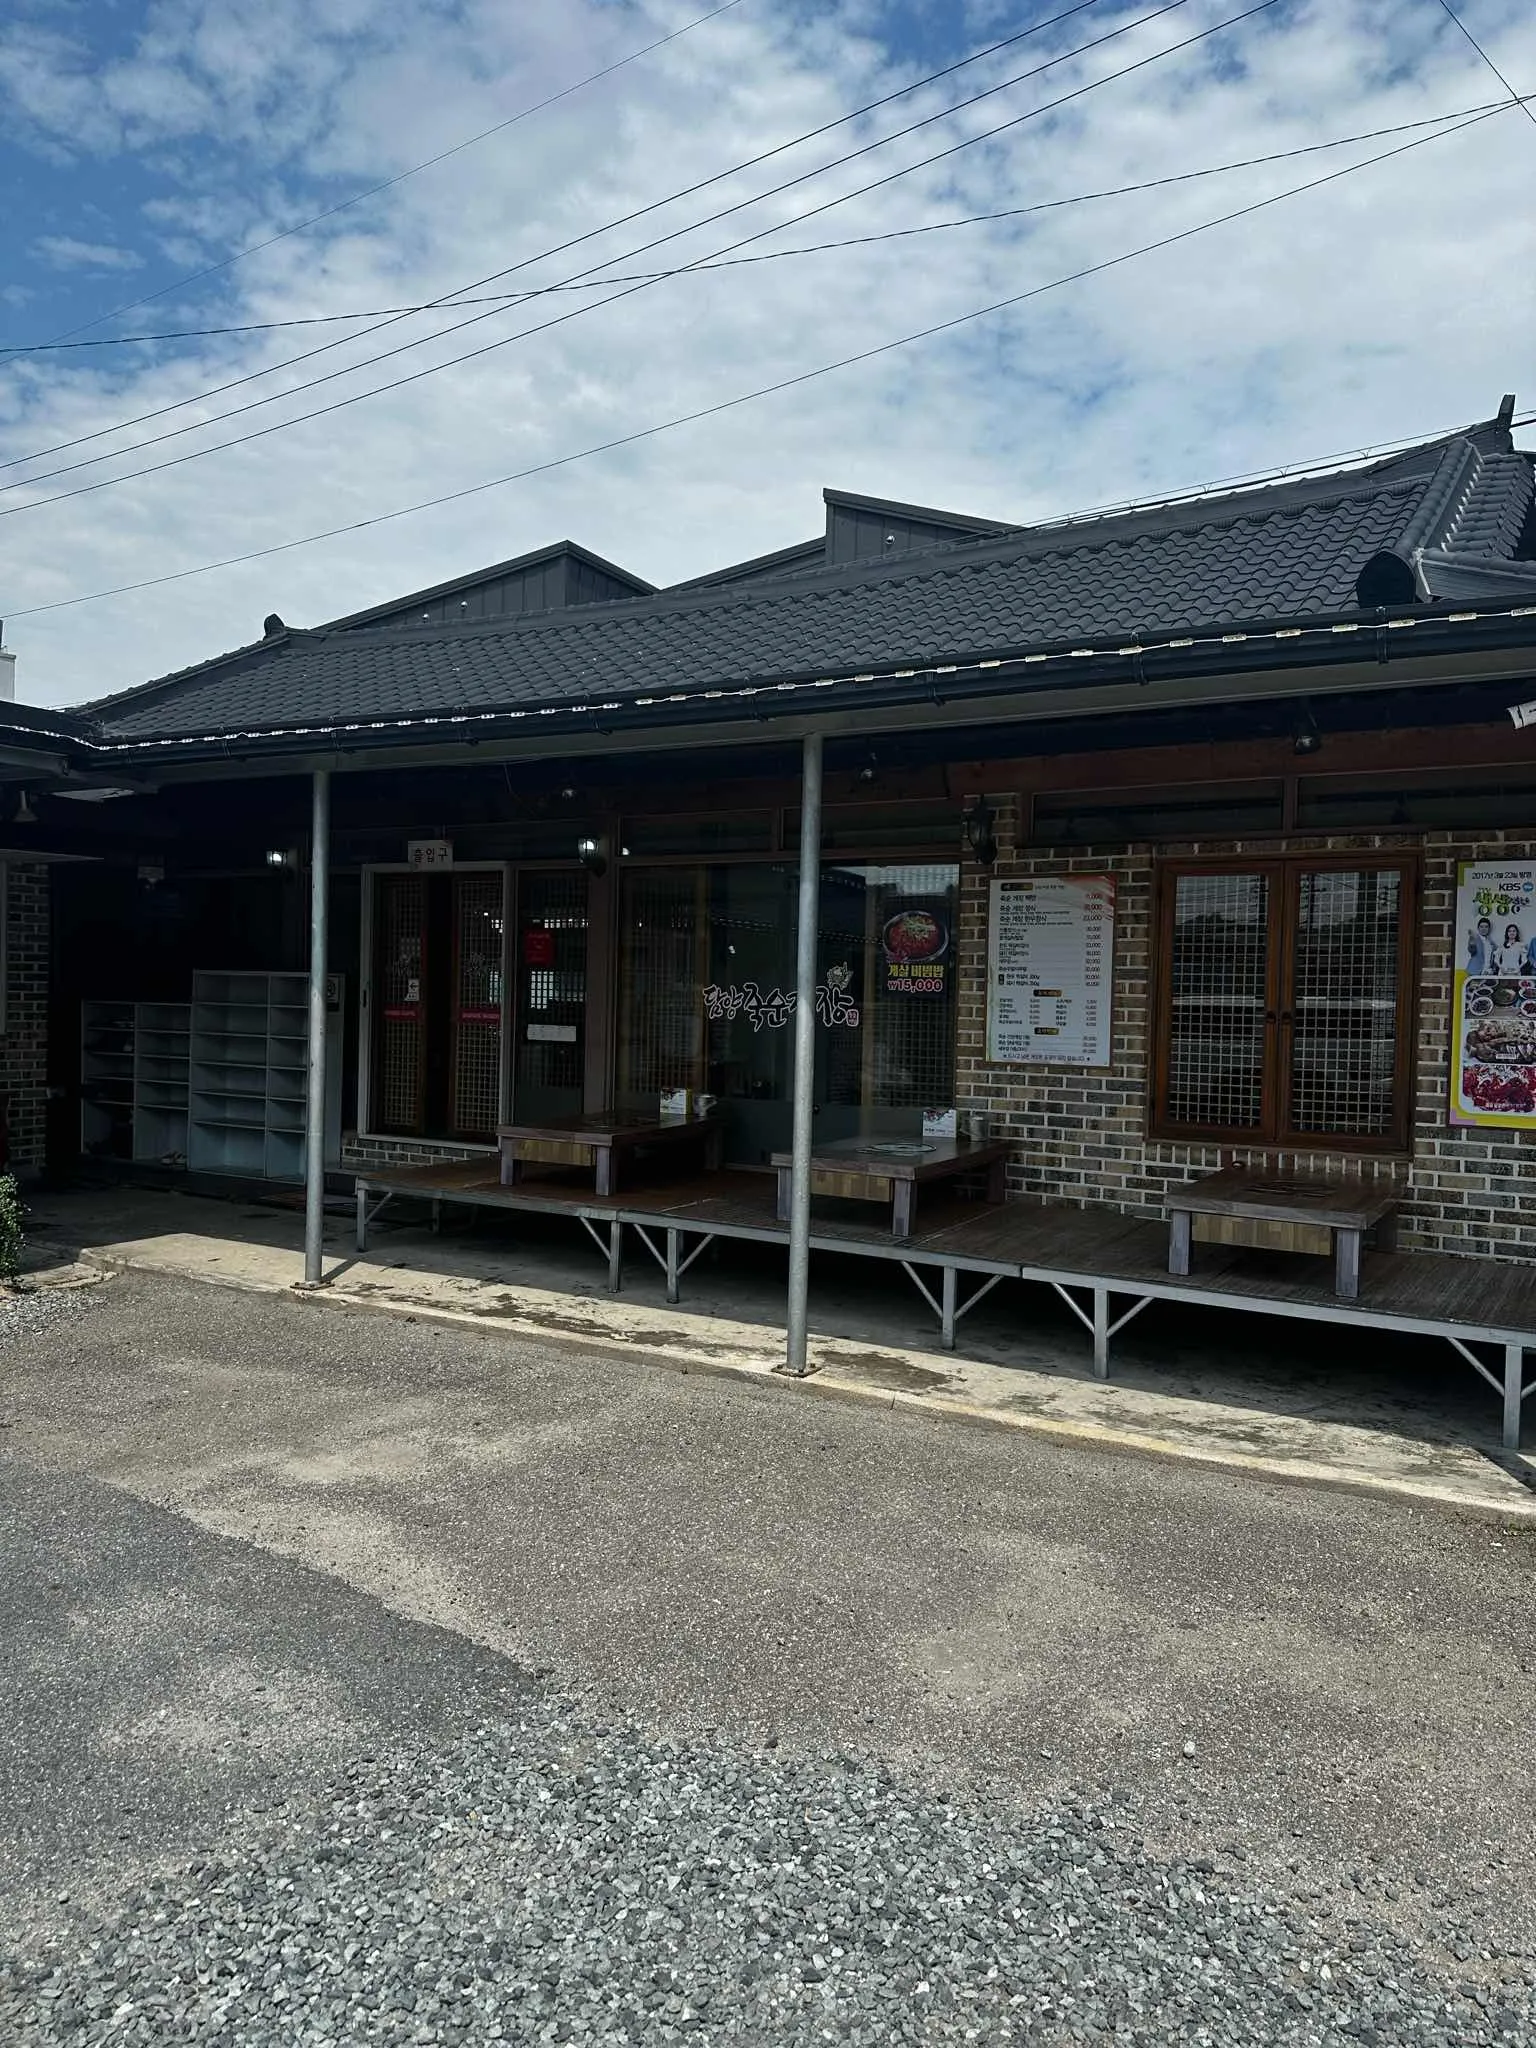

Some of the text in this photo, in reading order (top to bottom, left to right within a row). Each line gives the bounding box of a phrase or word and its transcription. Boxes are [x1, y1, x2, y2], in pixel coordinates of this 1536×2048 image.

[1498, 882, 1521, 891] KBS
[887, 964, 944, 978] 게살 비빔밥
